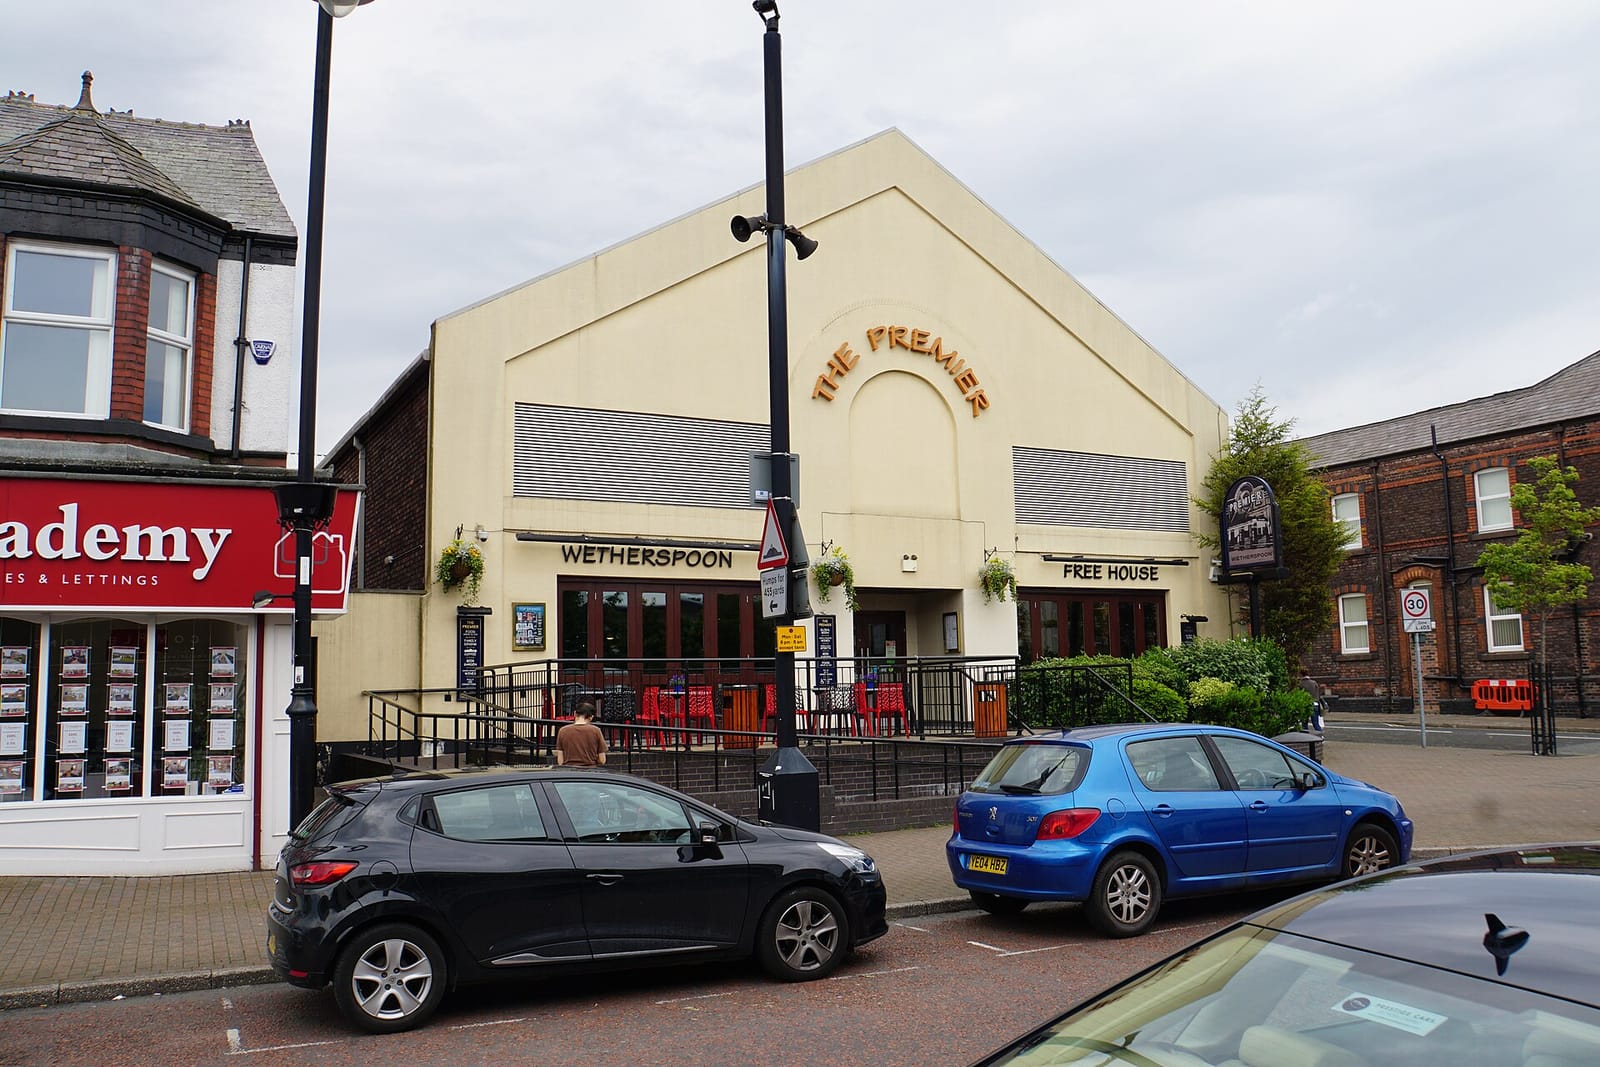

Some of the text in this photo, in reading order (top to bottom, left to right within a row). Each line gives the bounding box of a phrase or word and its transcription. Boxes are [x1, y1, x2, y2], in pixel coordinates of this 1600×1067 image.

[811, 325, 991, 418] THE PREMIER
[0, 502, 232, 581] ademy
[561, 544, 733, 568] WETHERSPOON
[5, 573, 160, 586] ES & LETTINGS
[1063, 563, 1159, 581] FREE HOUSE
[1407, 598, 1424, 610] 30
[971, 855, 1006, 872] YE04 HBZ
